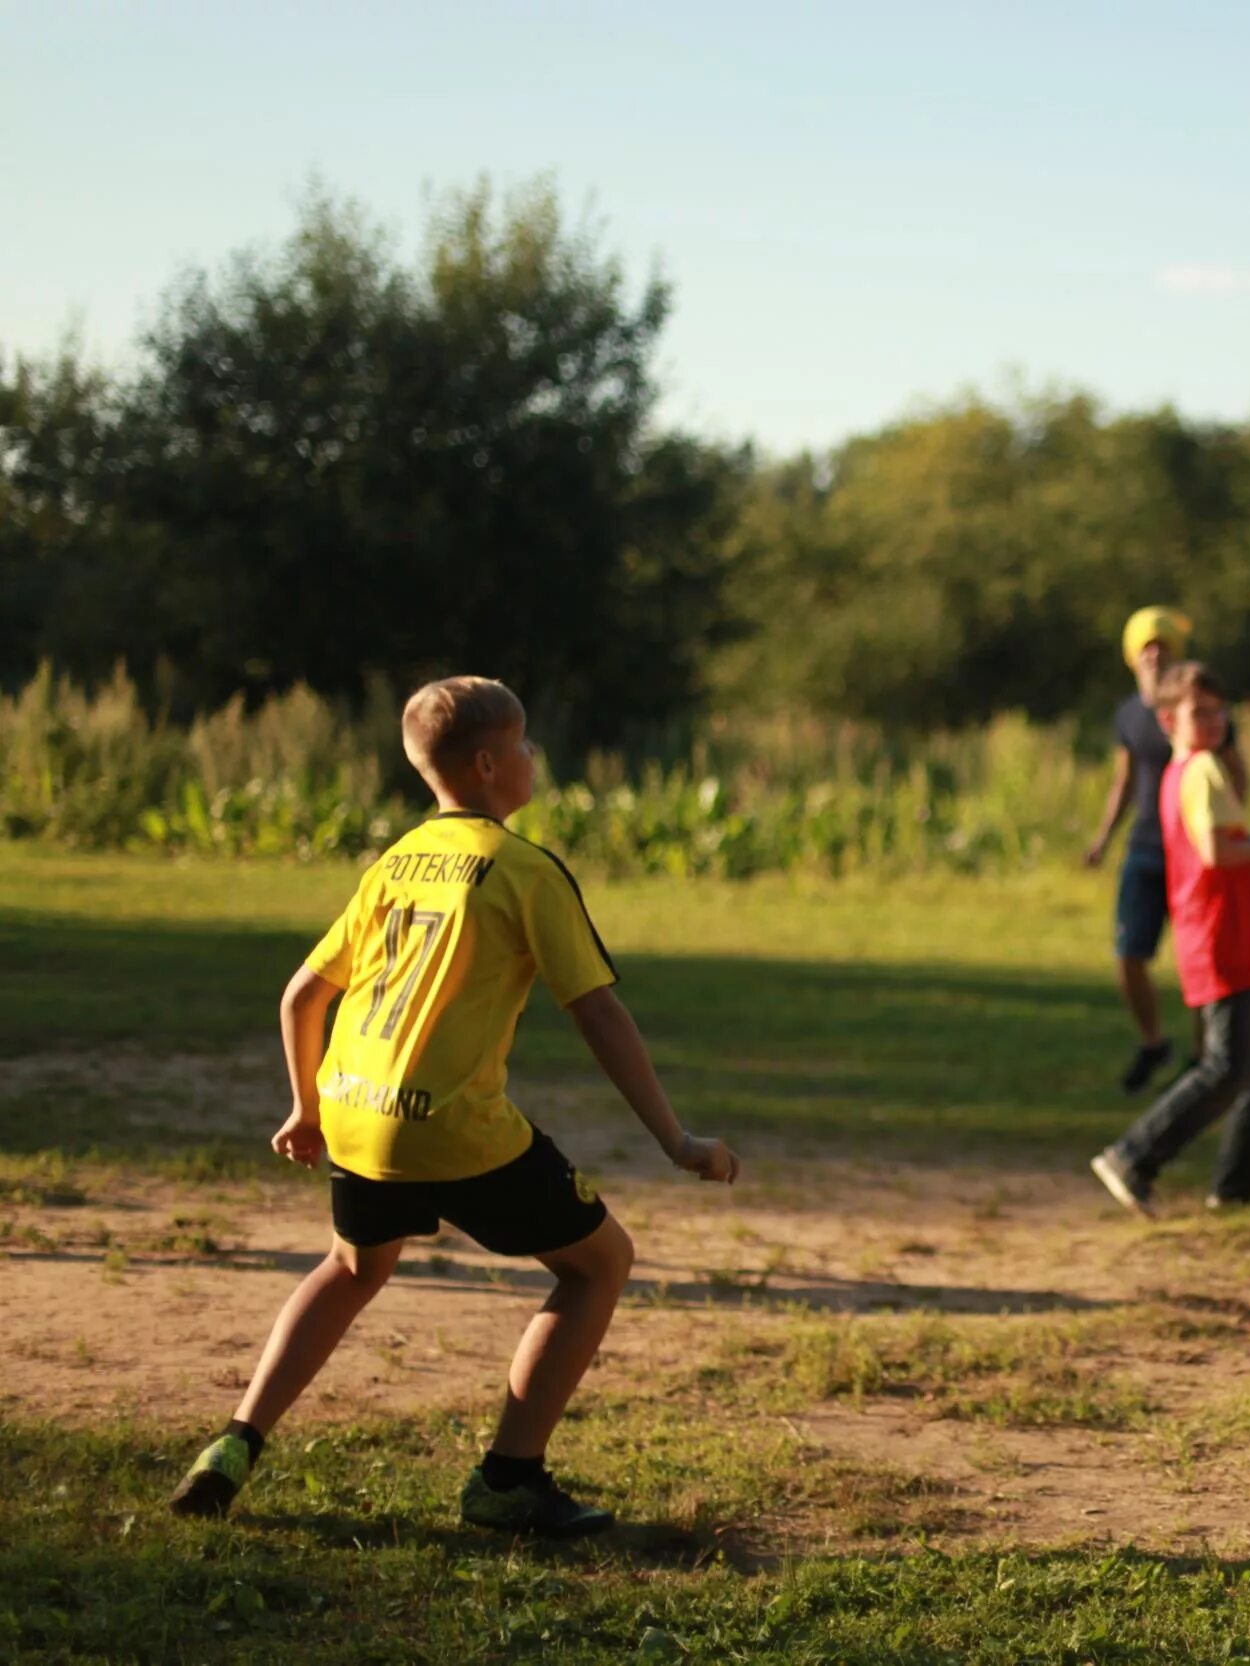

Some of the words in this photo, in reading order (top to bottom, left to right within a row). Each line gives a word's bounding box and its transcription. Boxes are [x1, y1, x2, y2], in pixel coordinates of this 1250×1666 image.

[385, 854, 496, 887] POTEKHIN
[361, 909, 445, 1040] 17
[328, 1072, 431, 1121] RTMUND
